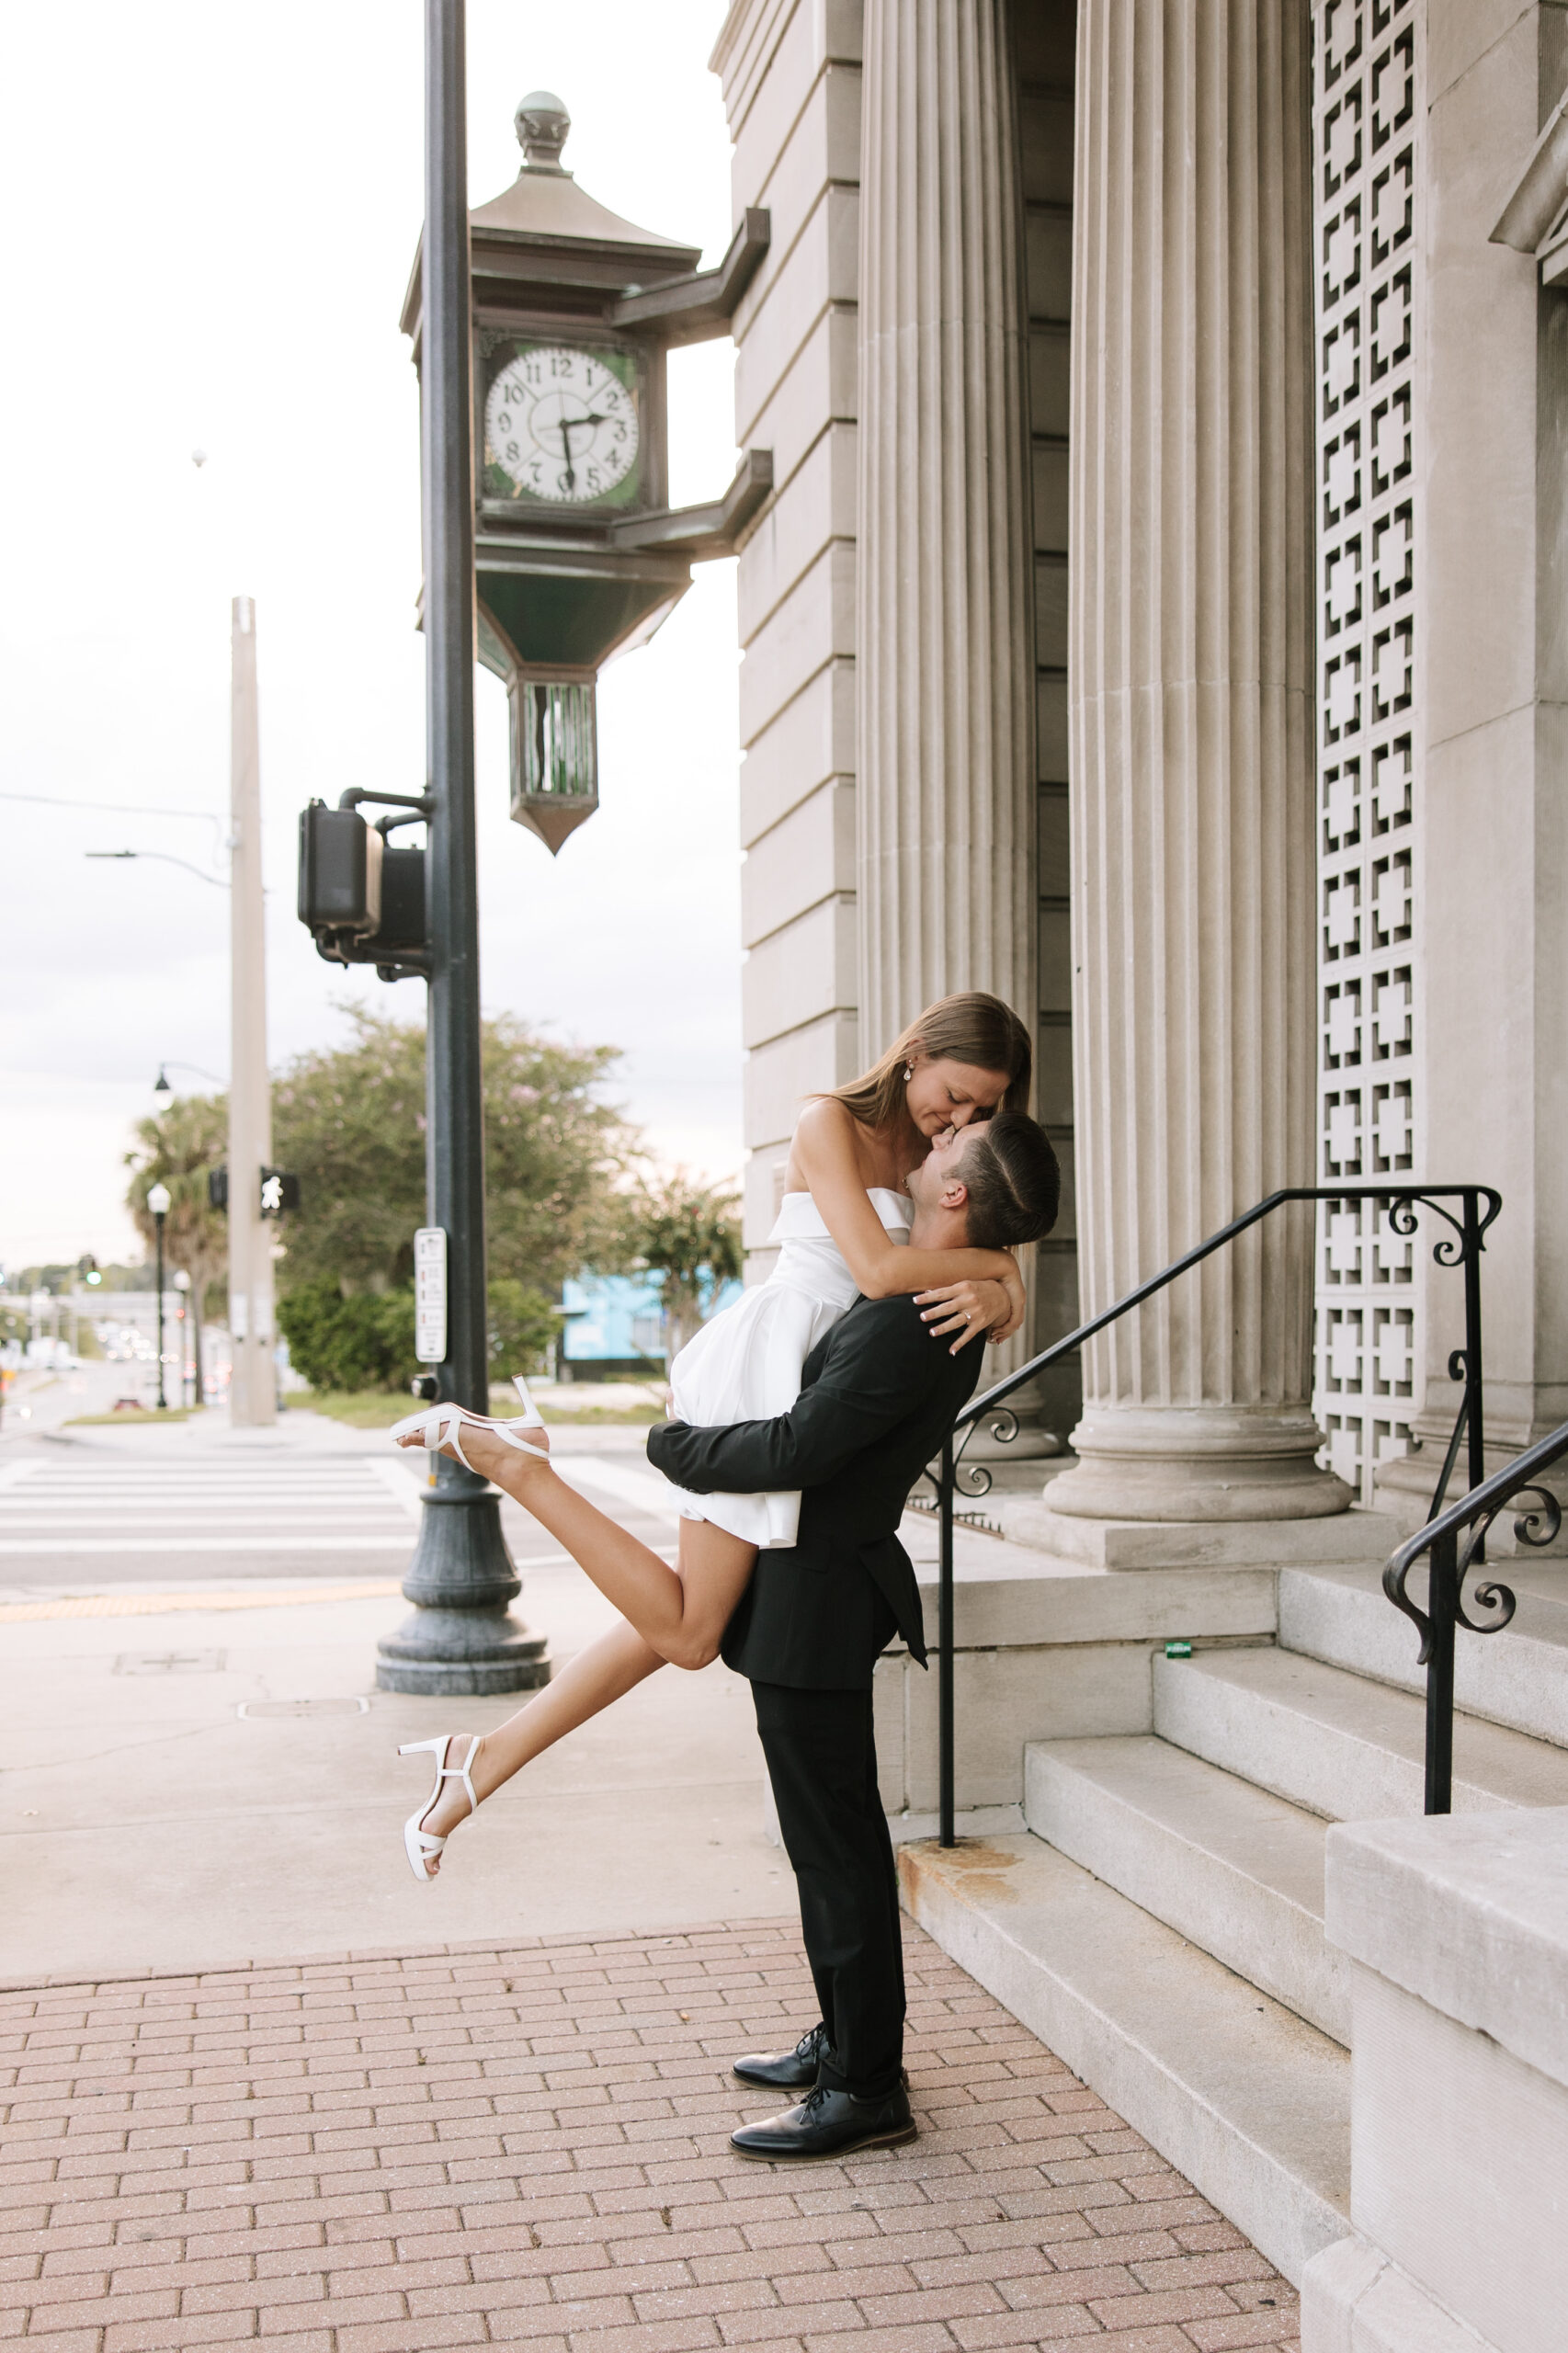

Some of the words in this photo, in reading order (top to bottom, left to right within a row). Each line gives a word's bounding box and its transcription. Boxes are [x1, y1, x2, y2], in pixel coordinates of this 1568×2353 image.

[527, 365, 540, 383] 11
[551, 358, 574, 377] 12
[586, 368, 593, 386] 1
[505, 384, 524, 404] 10
[607, 392, 619, 411] 2
[499, 414, 512, 433] 9
[614, 420, 627, 442] 3
[506, 441, 520, 462] 8
[606, 449, 619, 469] 4
[529, 462, 541, 482] 7
[587, 469, 601, 491] 5
